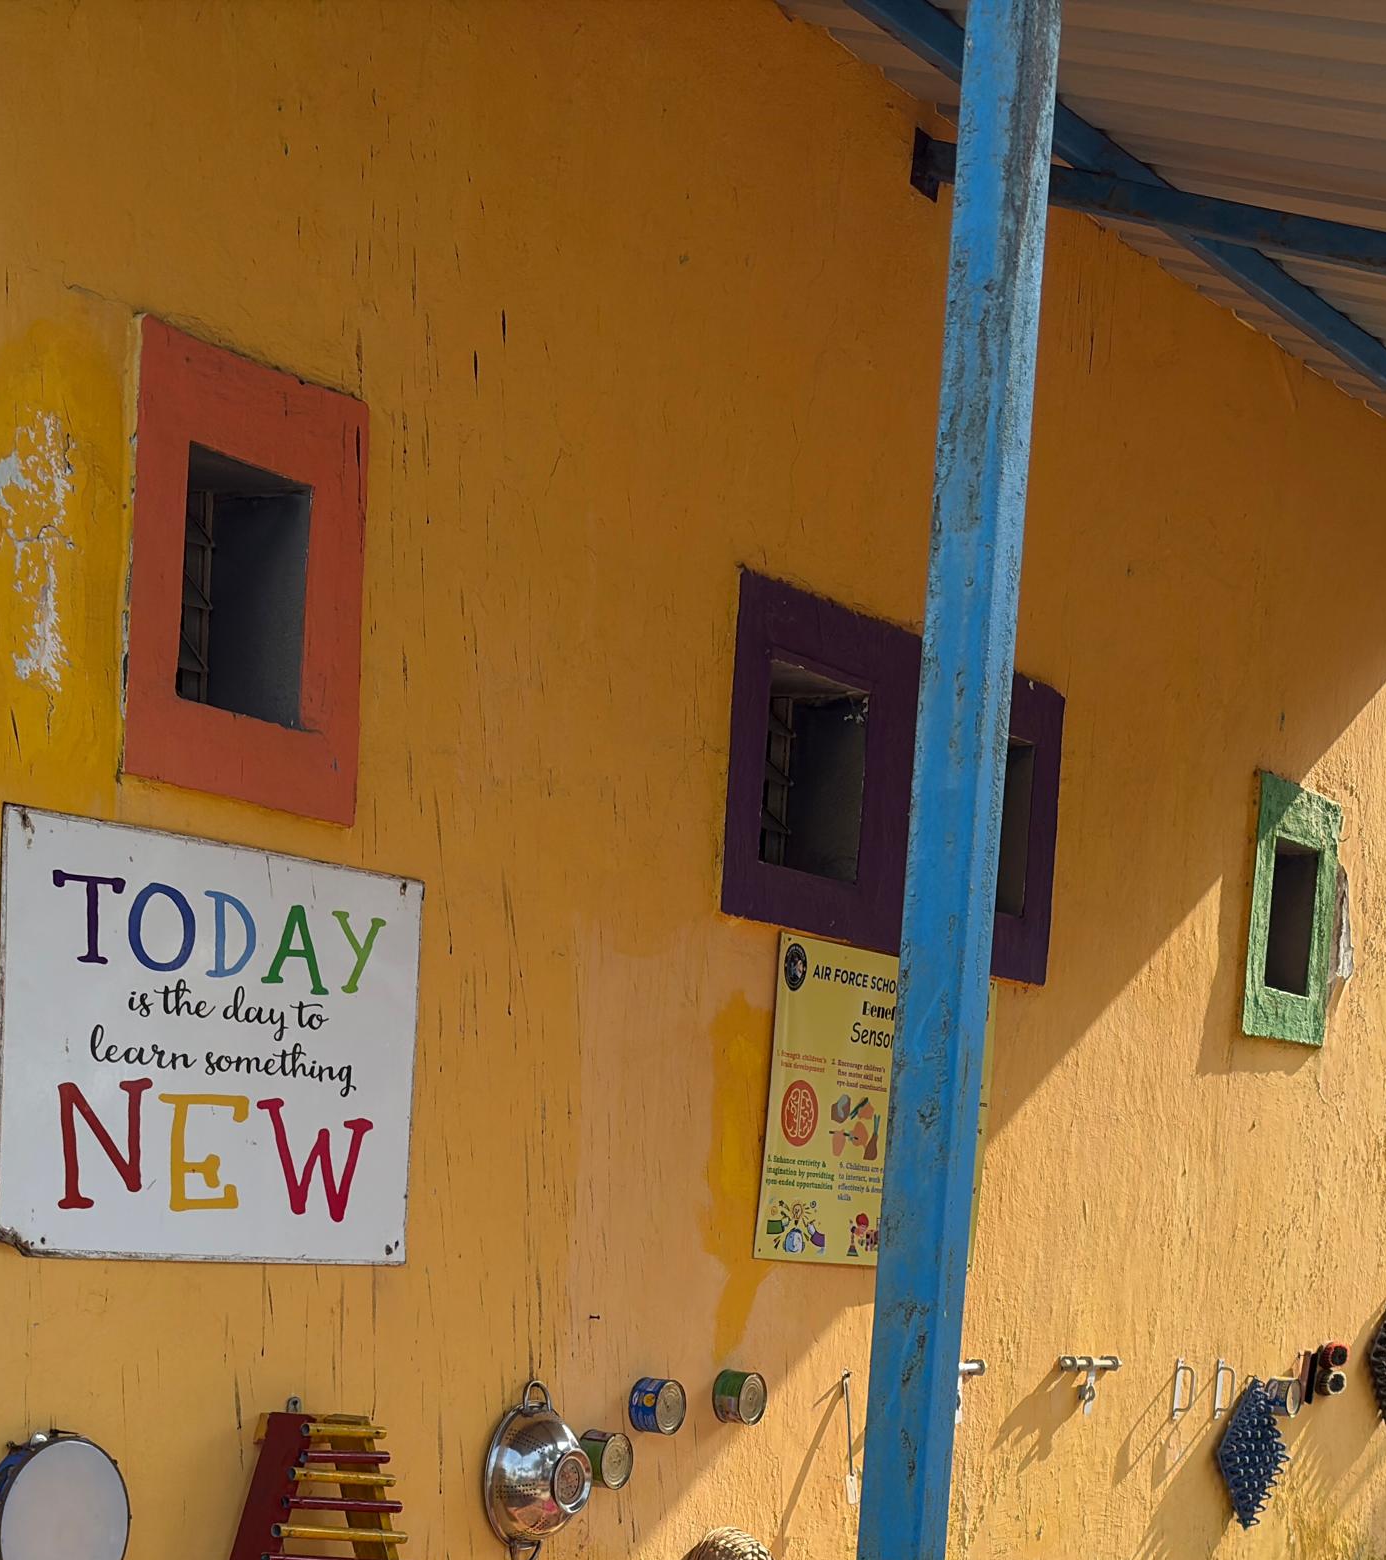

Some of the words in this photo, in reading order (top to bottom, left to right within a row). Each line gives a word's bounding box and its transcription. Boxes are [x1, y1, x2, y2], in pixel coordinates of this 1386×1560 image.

[52, 869, 386, 995] TODAY
[128, 990, 154, 1018] is
[154, 978, 216, 1019] the
[222, 985, 289, 1041] day
[289, 1000, 329, 1030] to
[813, 964, 831, 981] AIR
[833, 968, 869, 988] FORCE
[870, 976, 897, 994] SCHO
[90, 1024, 197, 1070] learn
[205, 1043, 357, 1098] something
[57, 1077, 374, 1223] NEW
